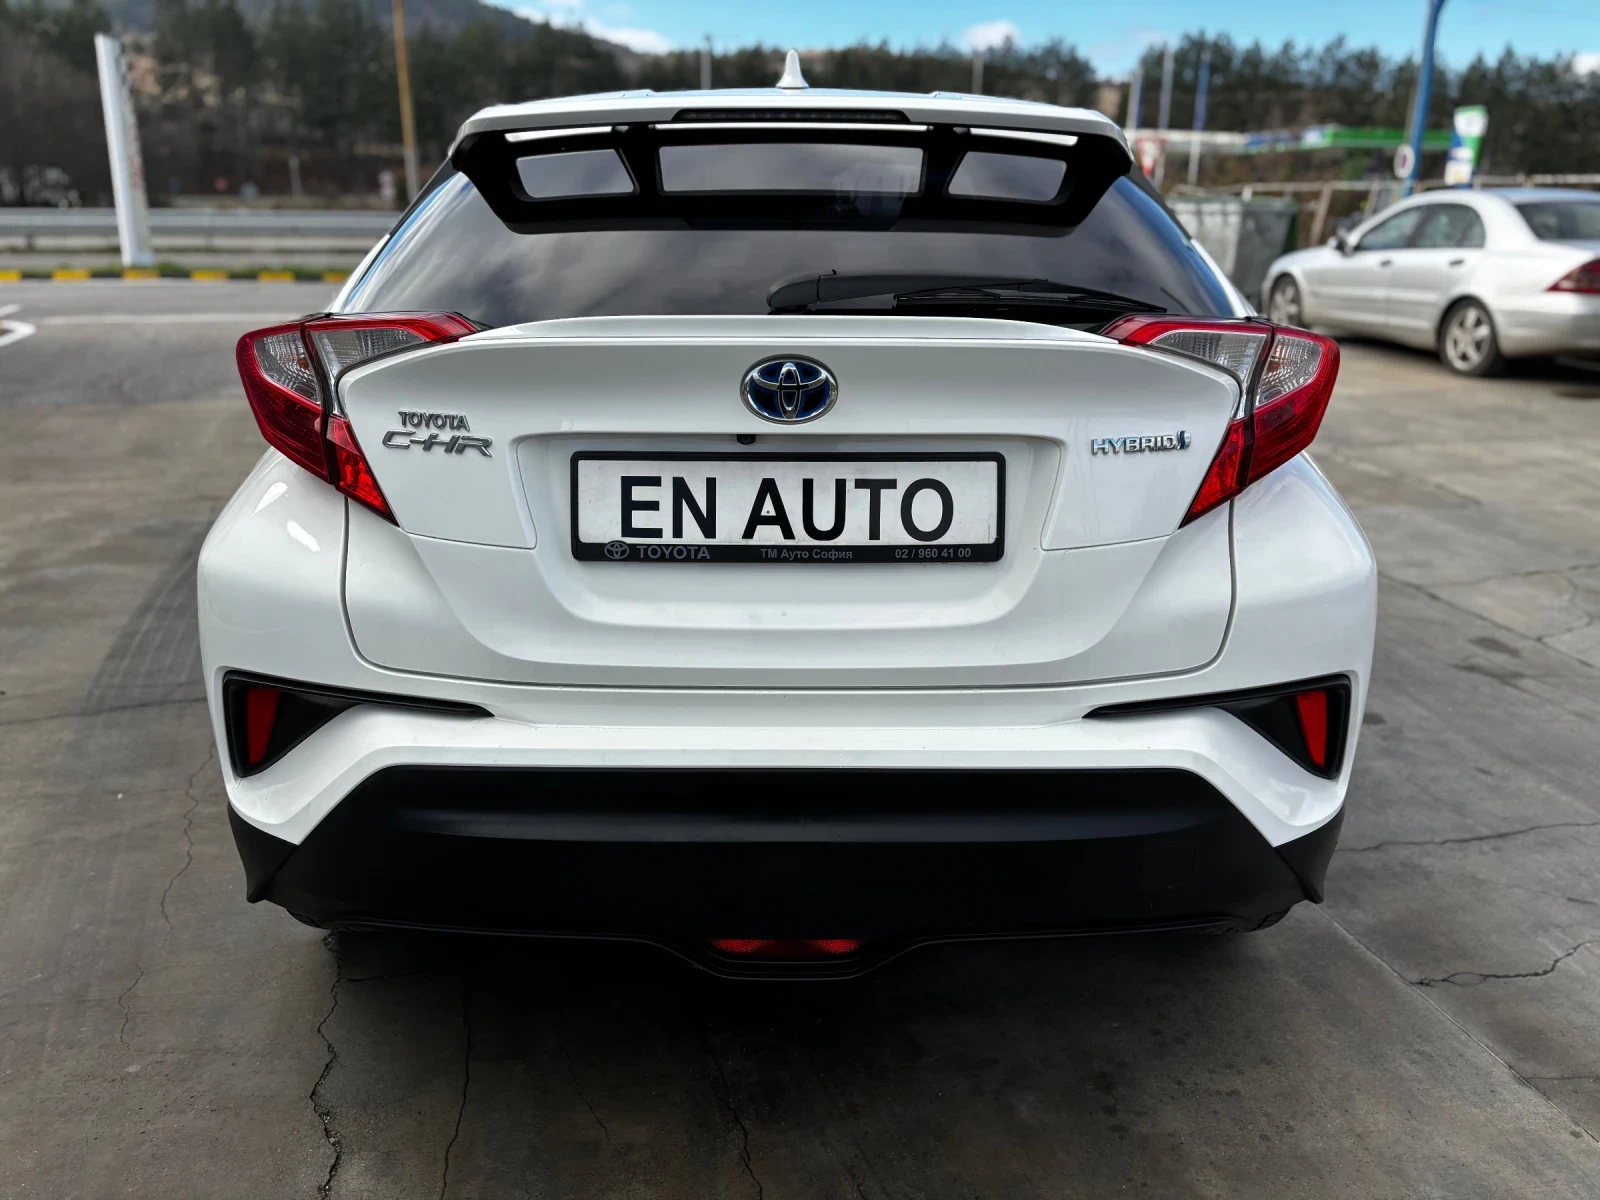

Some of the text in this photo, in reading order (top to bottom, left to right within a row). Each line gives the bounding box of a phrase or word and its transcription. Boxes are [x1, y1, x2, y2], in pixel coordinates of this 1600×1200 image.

[398, 411, 470, 431] TOYOTA
[382, 429, 493, 458] C-HR
[1091, 434, 1177, 455] HYBRID
[620, 475, 954, 542] EN AUTO
[636, 545, 711, 559] TOYOTA
[780, 548, 810, 560] Ауто
[812, 548, 853, 560] София
[895, 548, 909, 559] 02
[918, 548, 938, 558] 960
[941, 548, 954, 558] 41
[958, 547, 971, 558] 00
